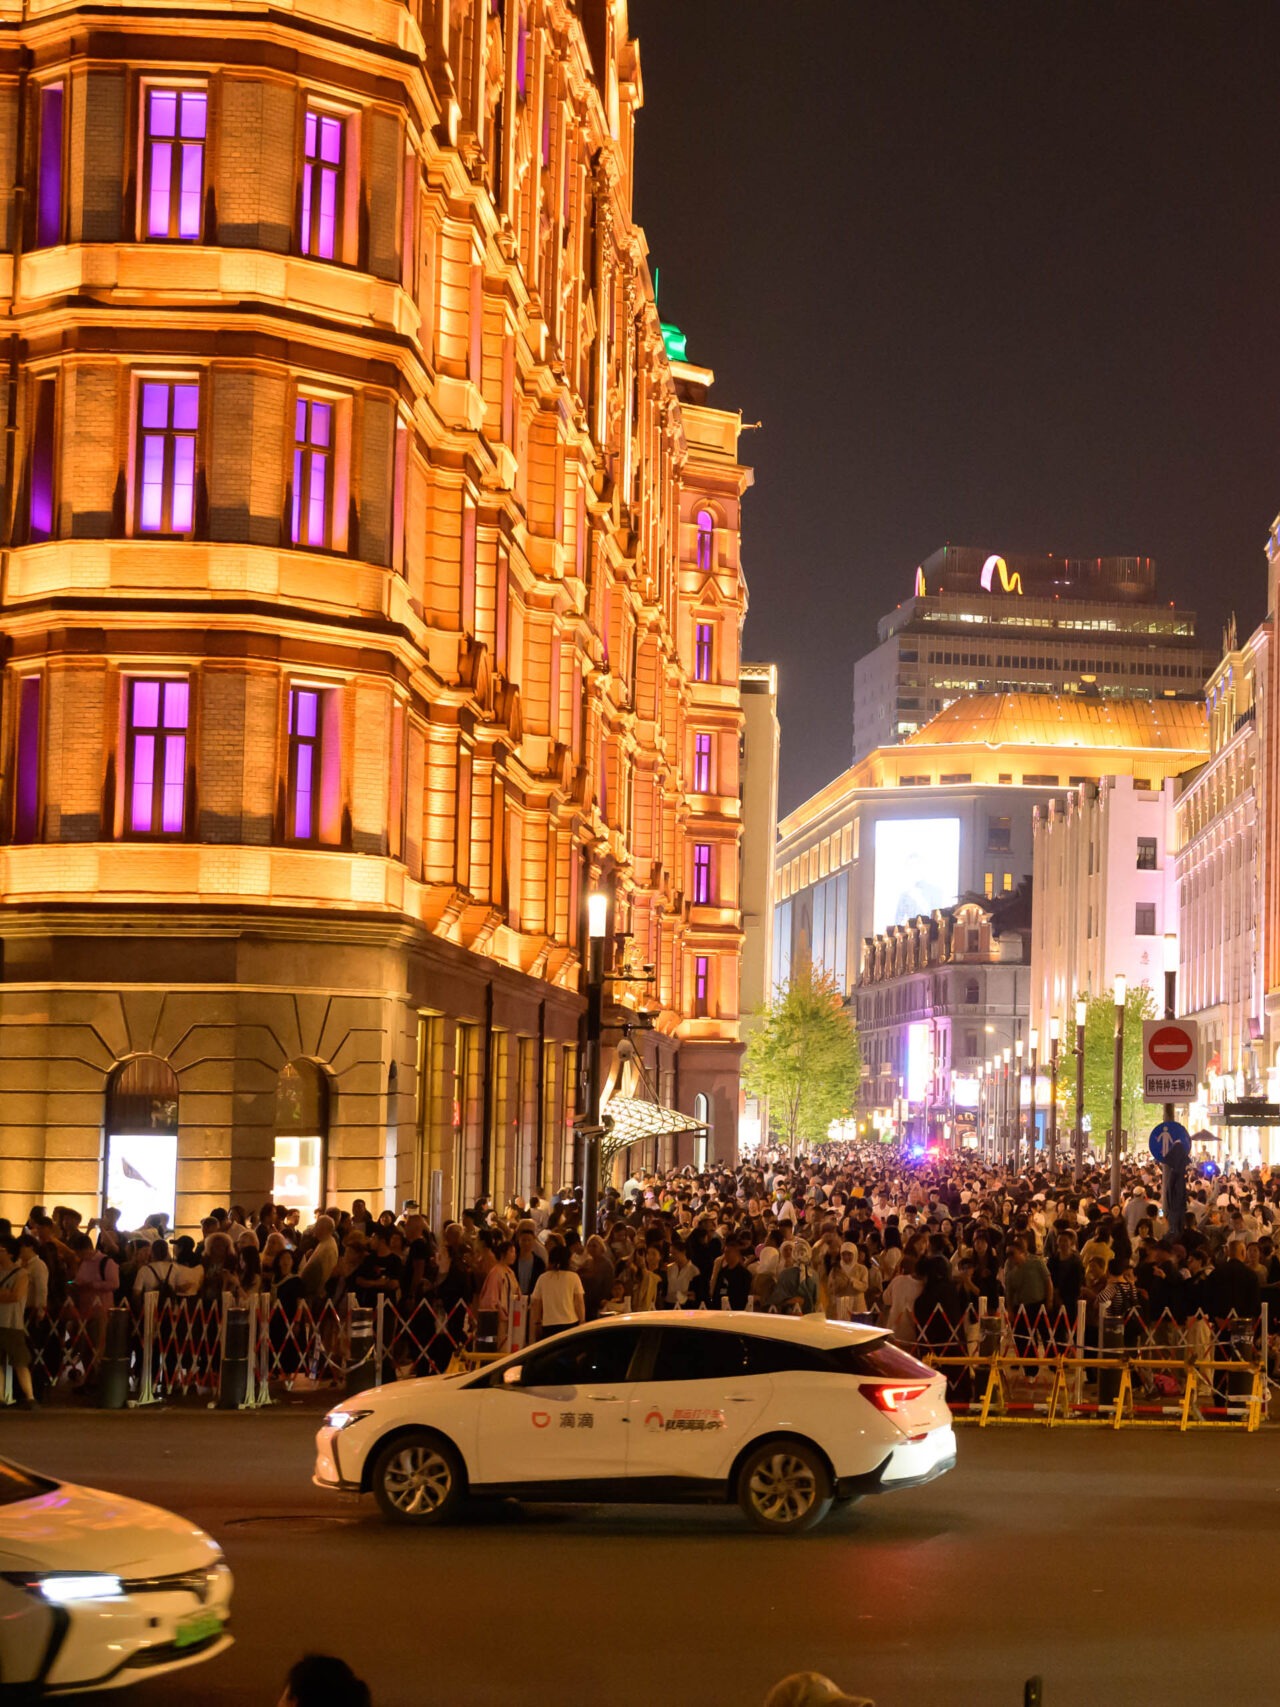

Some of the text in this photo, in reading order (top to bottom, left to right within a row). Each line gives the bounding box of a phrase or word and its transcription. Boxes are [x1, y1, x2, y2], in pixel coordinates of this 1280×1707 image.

[1148, 1079, 1193, 1092] 除特种车辆外
[559, 1411, 594, 1429] 滴滴
